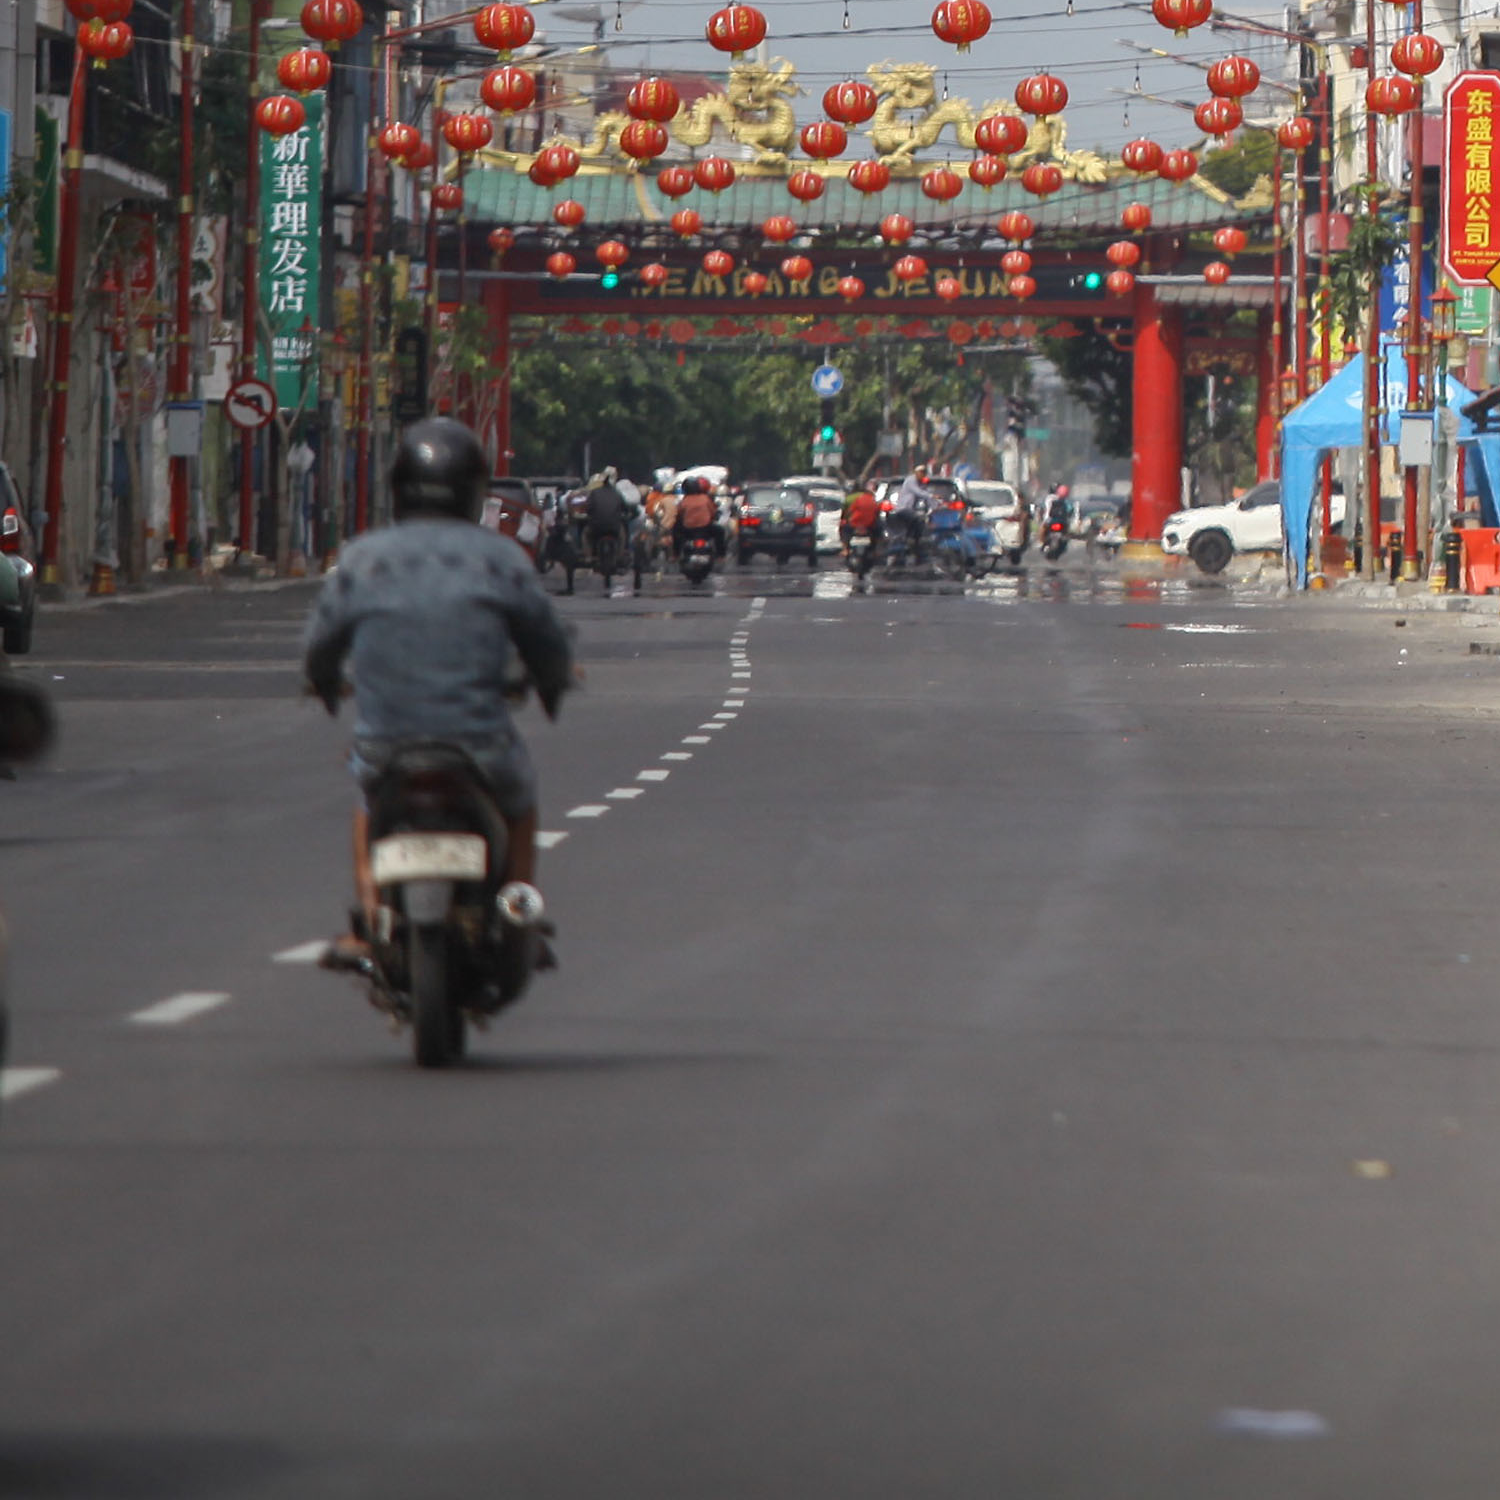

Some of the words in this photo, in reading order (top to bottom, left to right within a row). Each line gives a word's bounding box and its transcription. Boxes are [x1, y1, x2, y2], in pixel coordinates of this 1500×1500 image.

[269, 126, 310, 313] 新華理发店
[1465, 89, 1493, 249] 东盛有限公司
